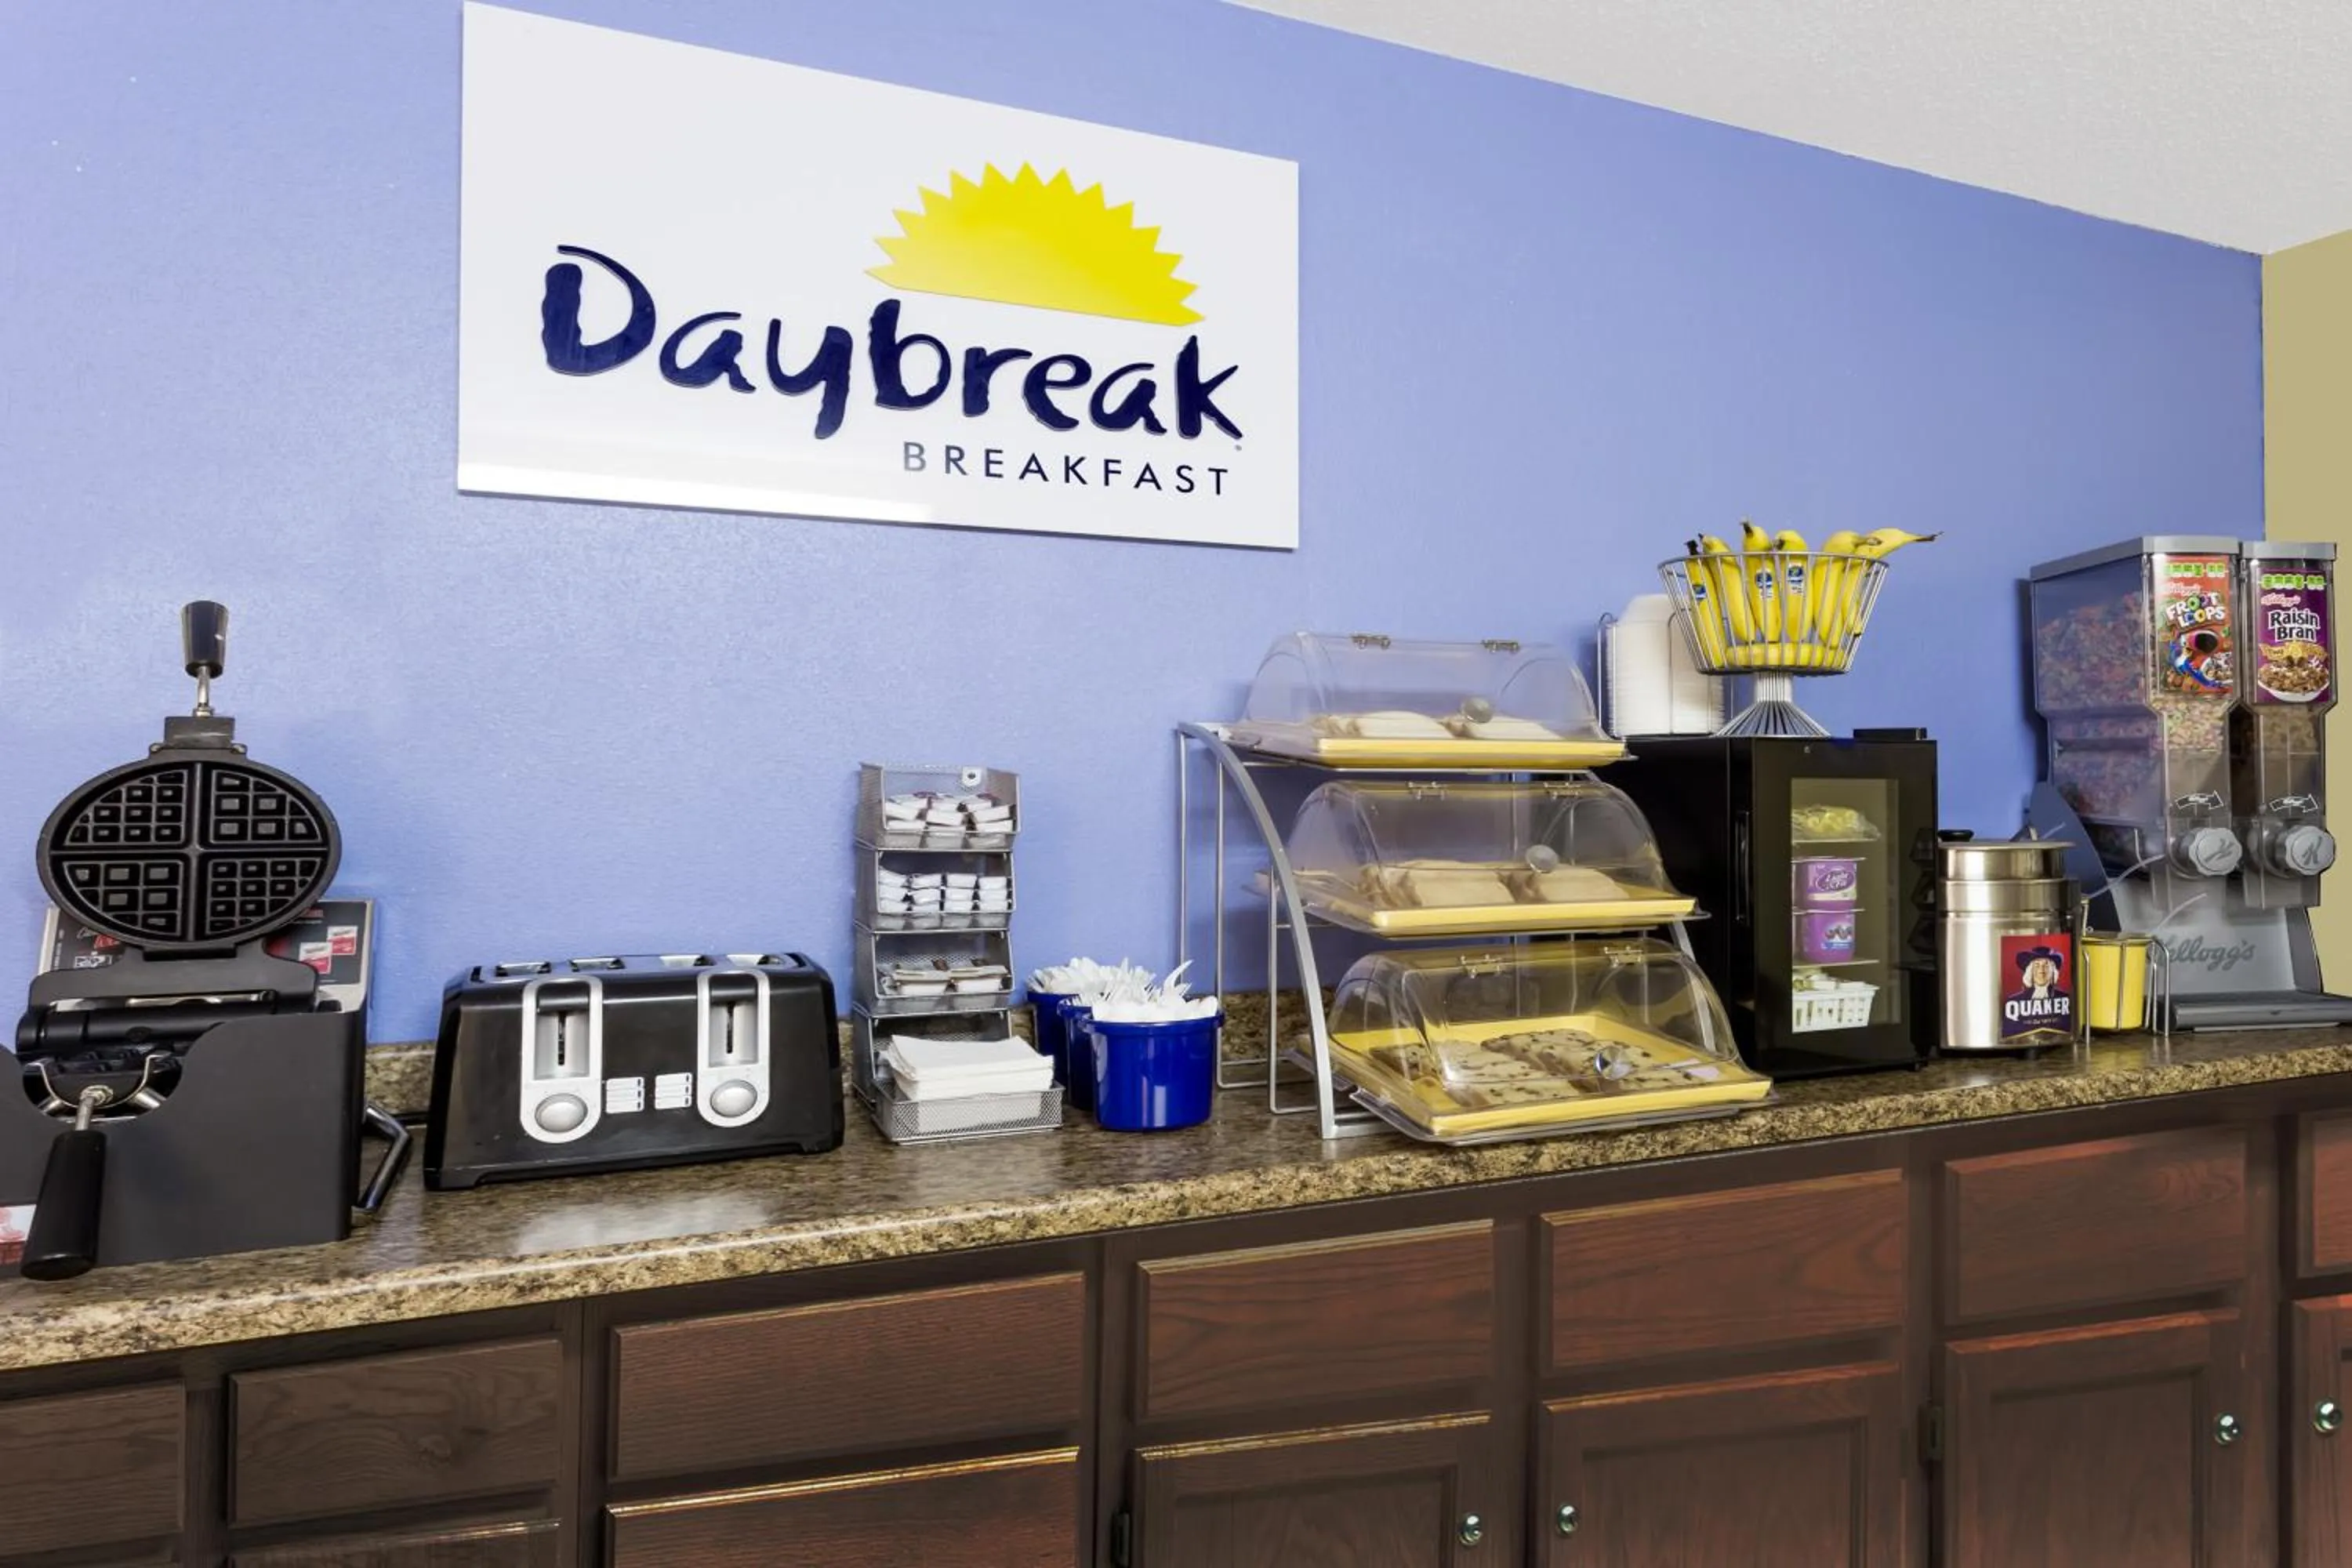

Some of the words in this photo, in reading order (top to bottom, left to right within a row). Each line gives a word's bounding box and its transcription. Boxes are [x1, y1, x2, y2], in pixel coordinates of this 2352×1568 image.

[540, 243, 1243, 440] Daybreak
[903, 441, 1229, 495] BREAKFAST
[2178, 606, 2226, 627] LOOPS
[2269, 608, 2320, 628] Raisin
[2276, 626, 2316, 641] Bran
[2005, 996, 2070, 1022] QUAKER
